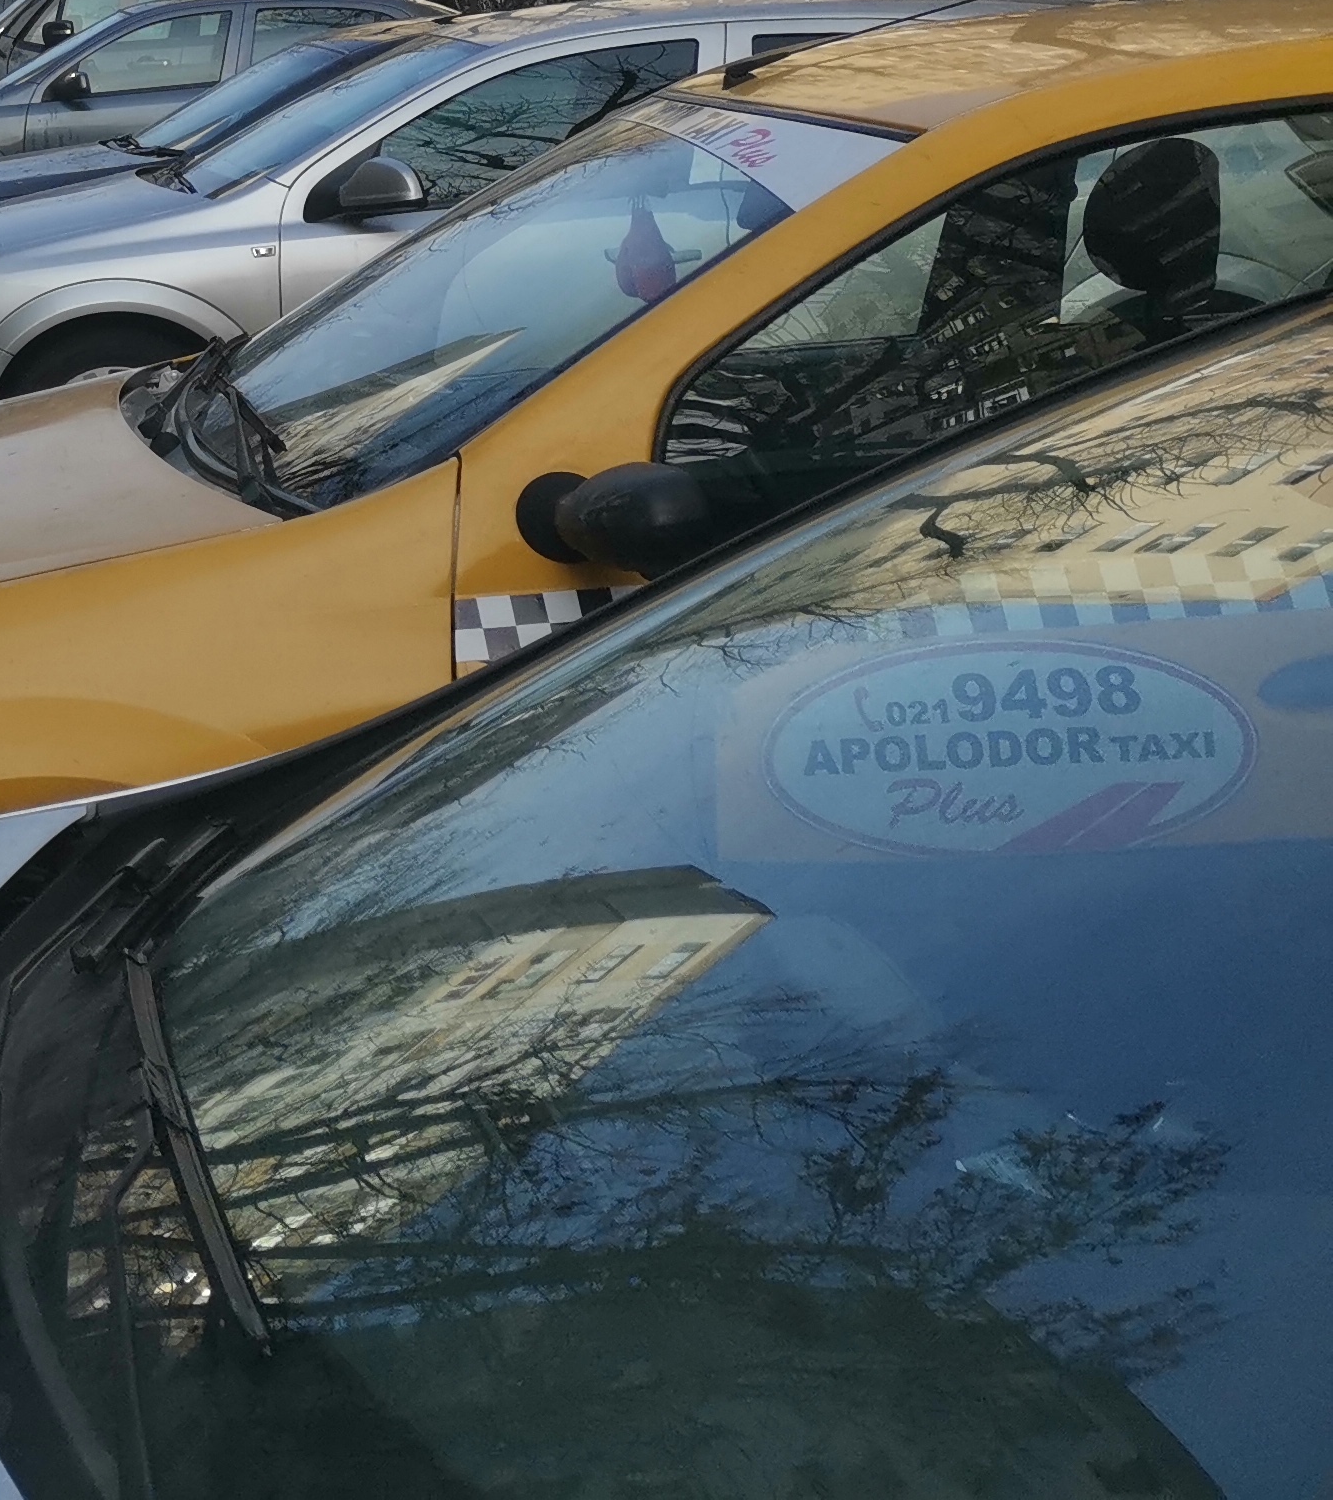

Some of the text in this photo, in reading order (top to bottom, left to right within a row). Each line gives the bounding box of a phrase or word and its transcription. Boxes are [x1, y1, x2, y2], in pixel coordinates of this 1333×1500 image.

[679, 111, 750, 146] TAXI
[714, 128, 778, 168] Plus
[884, 665, 1142, 727] 021 9498
[803, 726, 1216, 776] APOLODOR TAXI
[885, 777, 1026, 829] Plus
